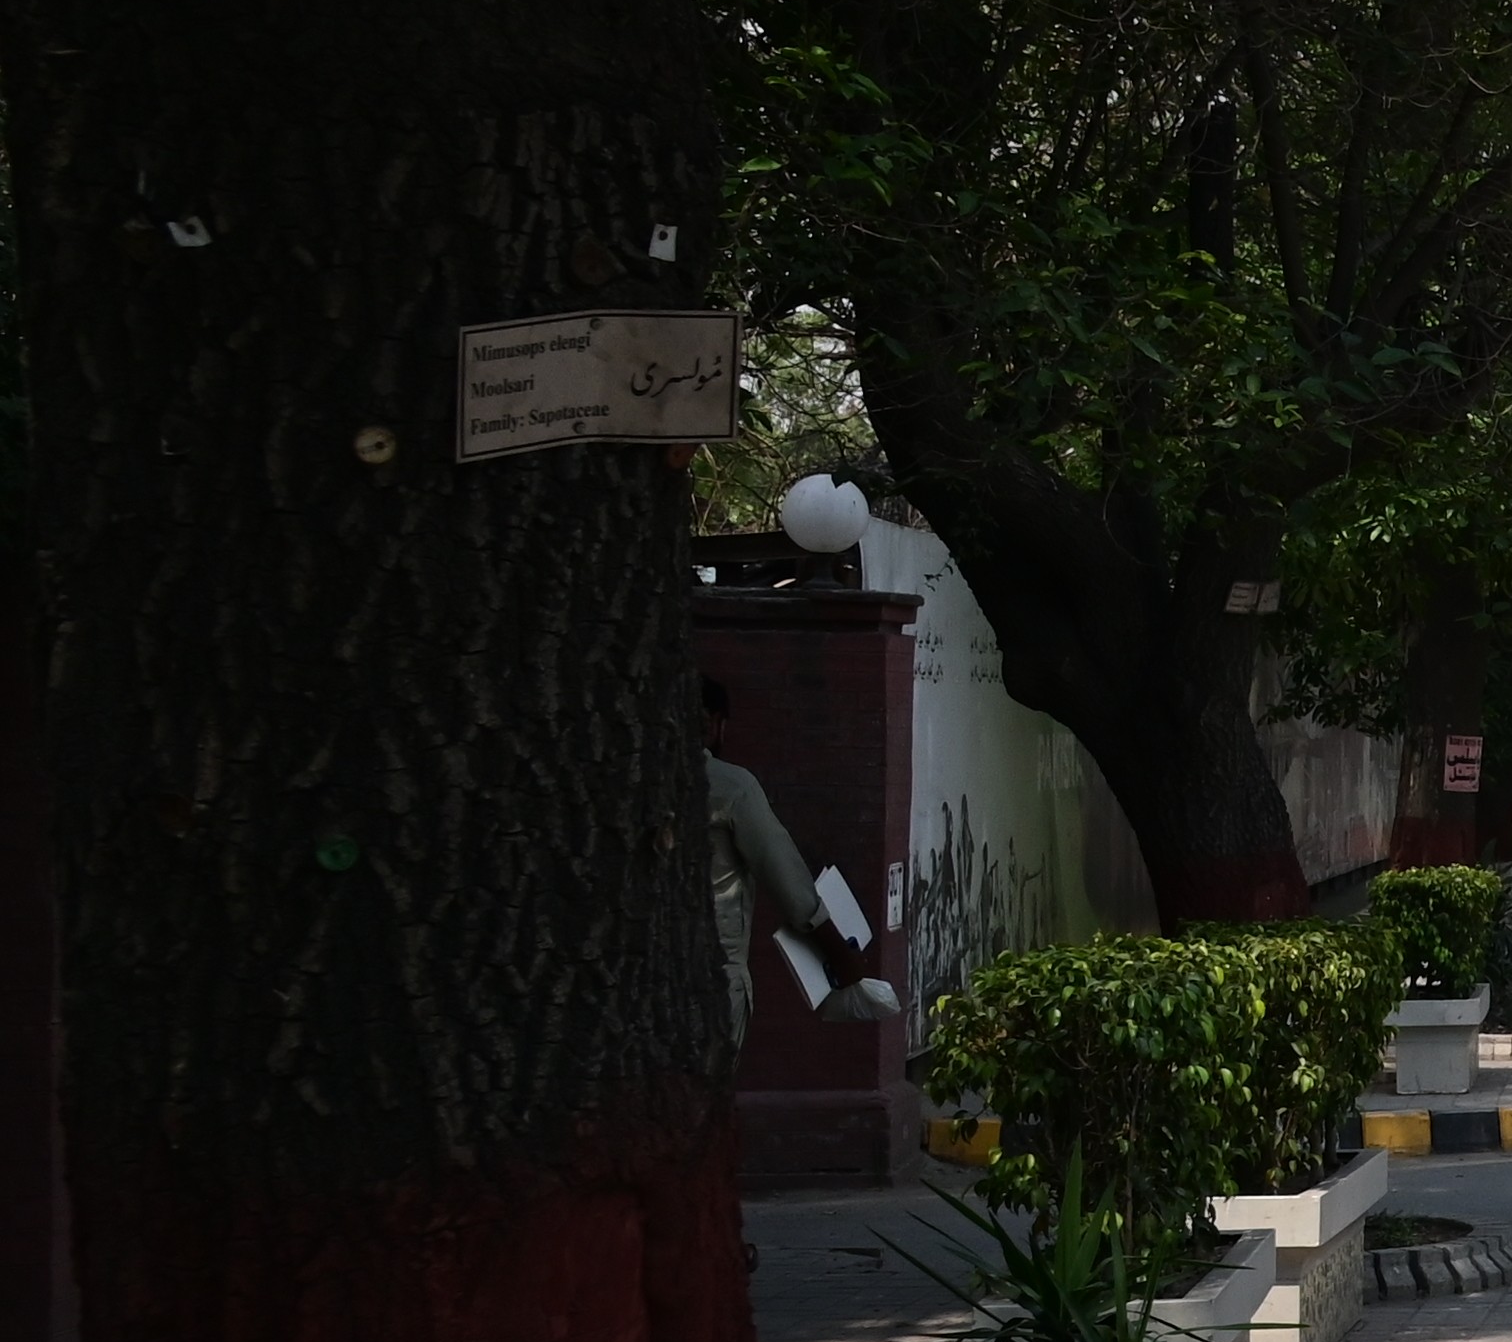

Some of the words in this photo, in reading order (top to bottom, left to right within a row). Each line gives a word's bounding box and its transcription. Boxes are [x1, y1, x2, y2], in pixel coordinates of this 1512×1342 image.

[472, 338, 546, 362] Mimusops
[550, 331, 592, 354] elengi
[470, 374, 535, 399] Moolsari
[470, 412, 525, 435] Family:
[528, 403, 610, 427] Sapotaceae
